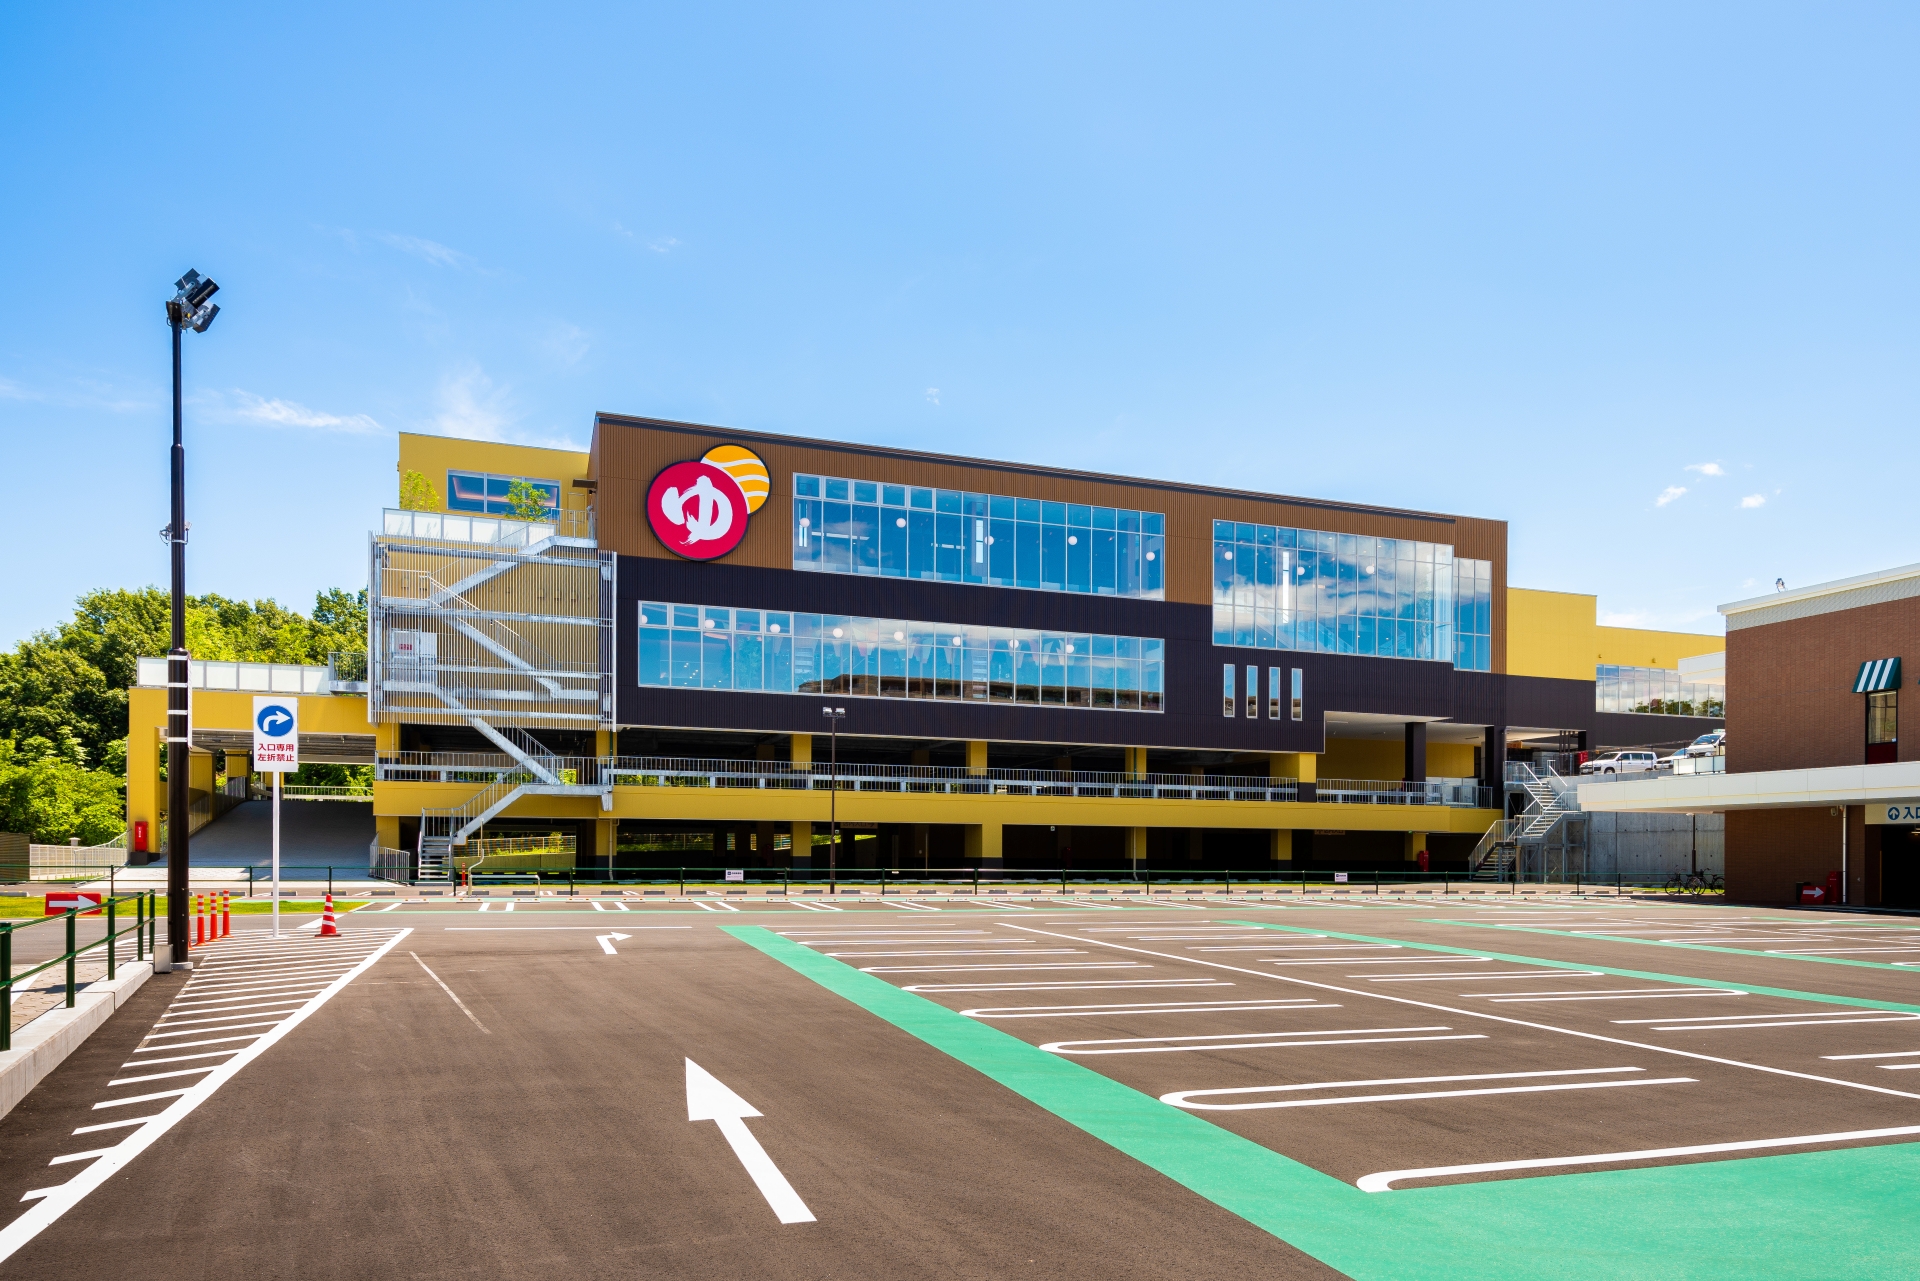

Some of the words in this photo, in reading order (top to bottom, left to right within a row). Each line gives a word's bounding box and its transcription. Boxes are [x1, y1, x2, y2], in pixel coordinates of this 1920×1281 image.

[661, 475, 733, 546] ゆ
[258, 743, 294, 752] 入口専用
[258, 753, 295, 762] 左折禁止
